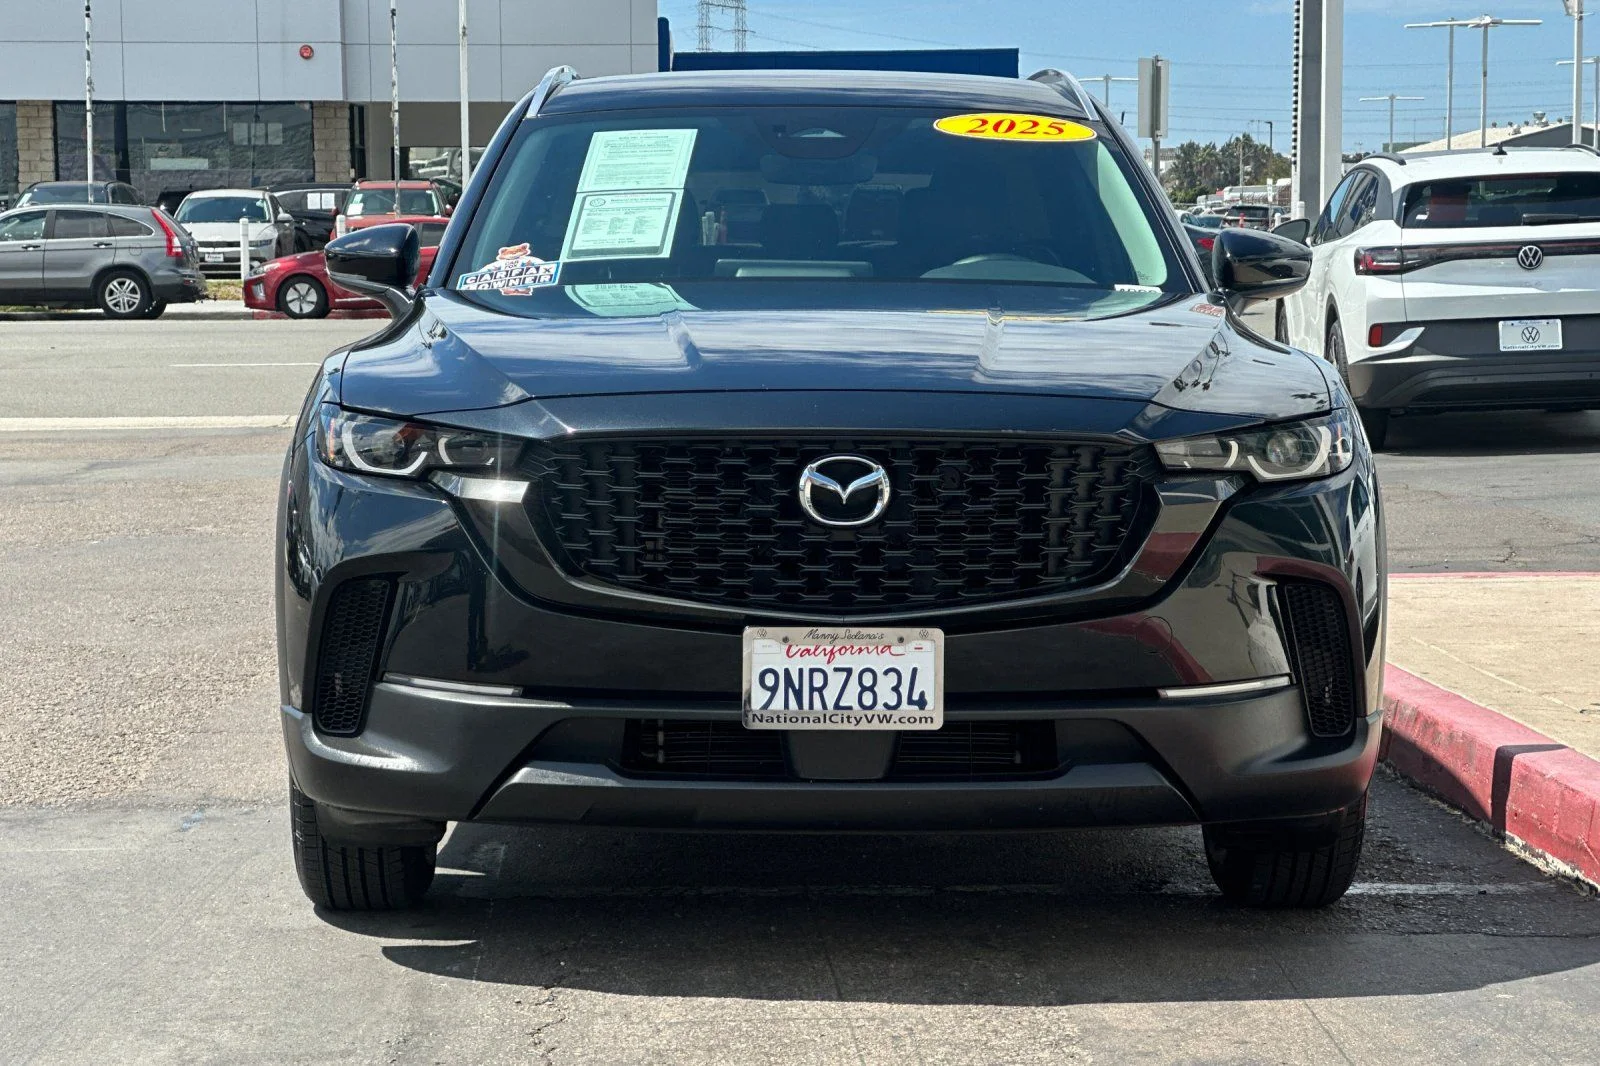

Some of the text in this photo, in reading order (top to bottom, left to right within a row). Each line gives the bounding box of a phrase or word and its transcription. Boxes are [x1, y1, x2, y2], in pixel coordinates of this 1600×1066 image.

[966, 118, 1067, 135] 2025
[465, 267, 552, 284] CARFAX
[803, 628, 839, 644] Manny
[786, 644, 906, 665] California
[758, 666, 928, 711] 9NRZ834
[752, 713, 934, 727] NationalCityVW.com
